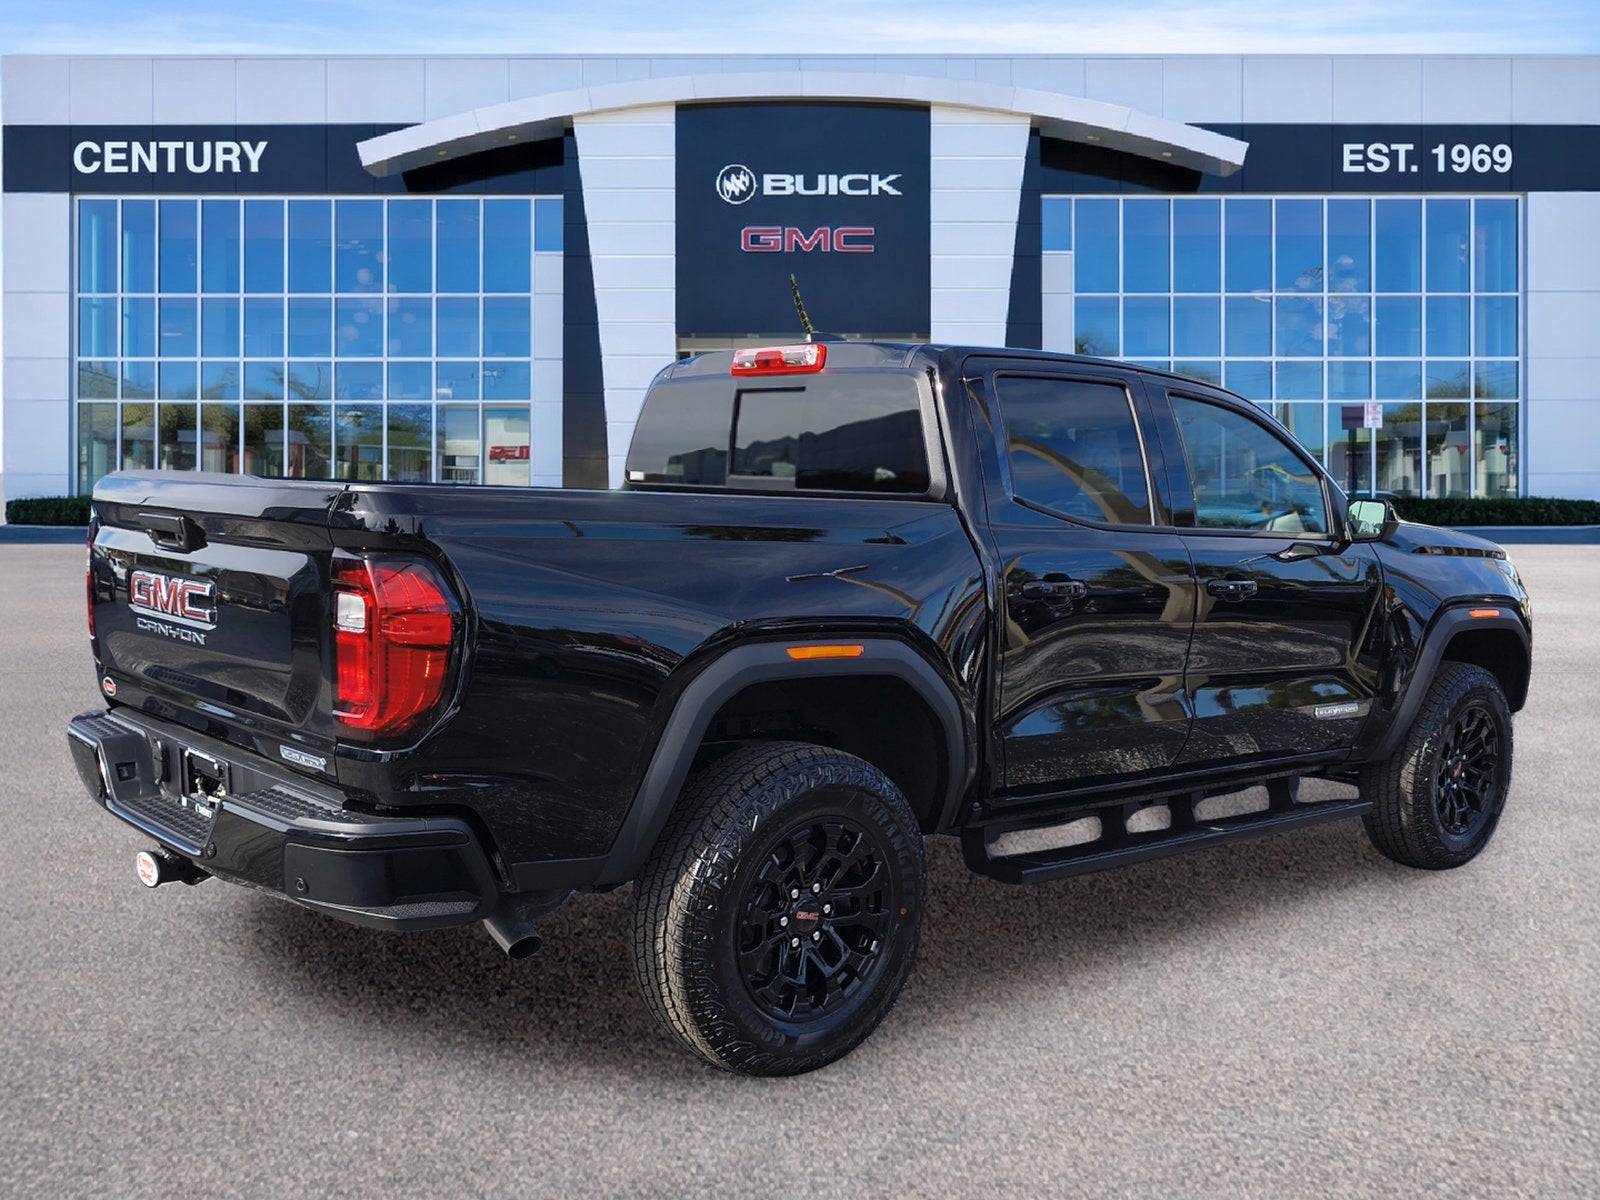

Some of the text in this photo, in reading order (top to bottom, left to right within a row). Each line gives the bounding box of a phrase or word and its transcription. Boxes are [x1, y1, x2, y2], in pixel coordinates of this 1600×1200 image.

[73, 140, 268, 174] CENTURY
[1342, 143, 1513, 173] EST. 1969
[763, 173, 903, 196] BUICK
[741, 226, 875, 253] GMC
[130, 569, 215, 623] GMC
[136, 617, 207, 646] CANYON
